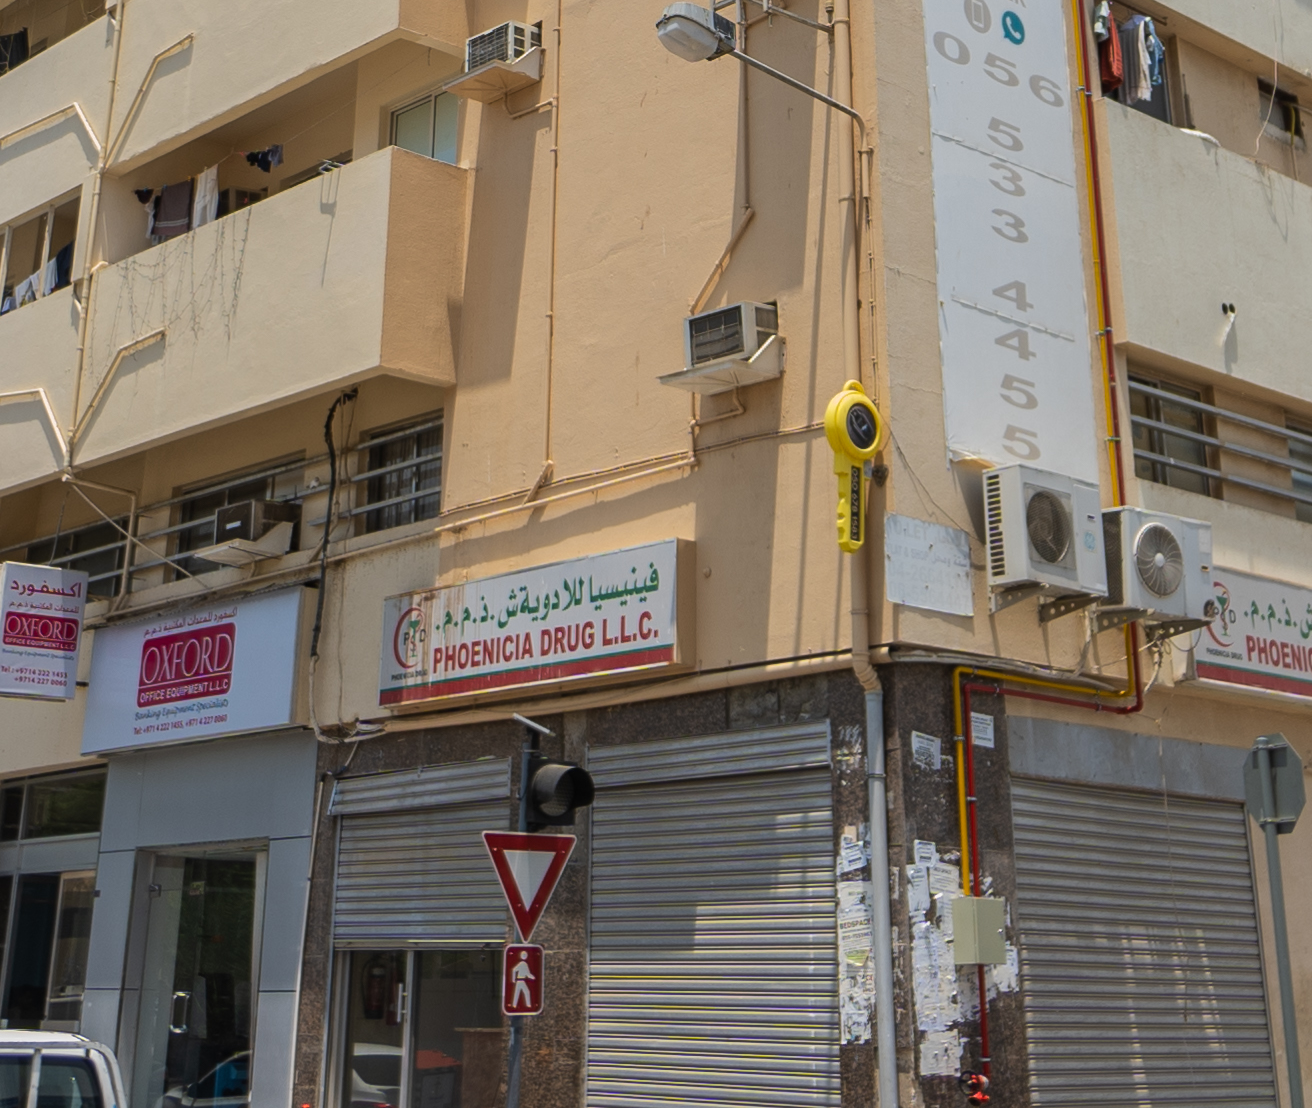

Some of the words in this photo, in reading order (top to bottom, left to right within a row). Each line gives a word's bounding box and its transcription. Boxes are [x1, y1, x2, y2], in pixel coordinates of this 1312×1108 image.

[589, 562, 660, 611] فينيسيا
[4, 636, 26, 645] OFFICE
[27, 639, 60, 649] EQUIPMENT
[5, 615, 77, 641] OXFORD
[432, 632, 534, 674] PHOENICIA
[540, 620, 595, 657] DRUG
[602, 611, 659, 648] L.L.C.
[142, 633, 233, 684] OXFORD
[139, 689, 168, 703] OFFICE
[166, 682, 208, 699] EQUIPMENT
